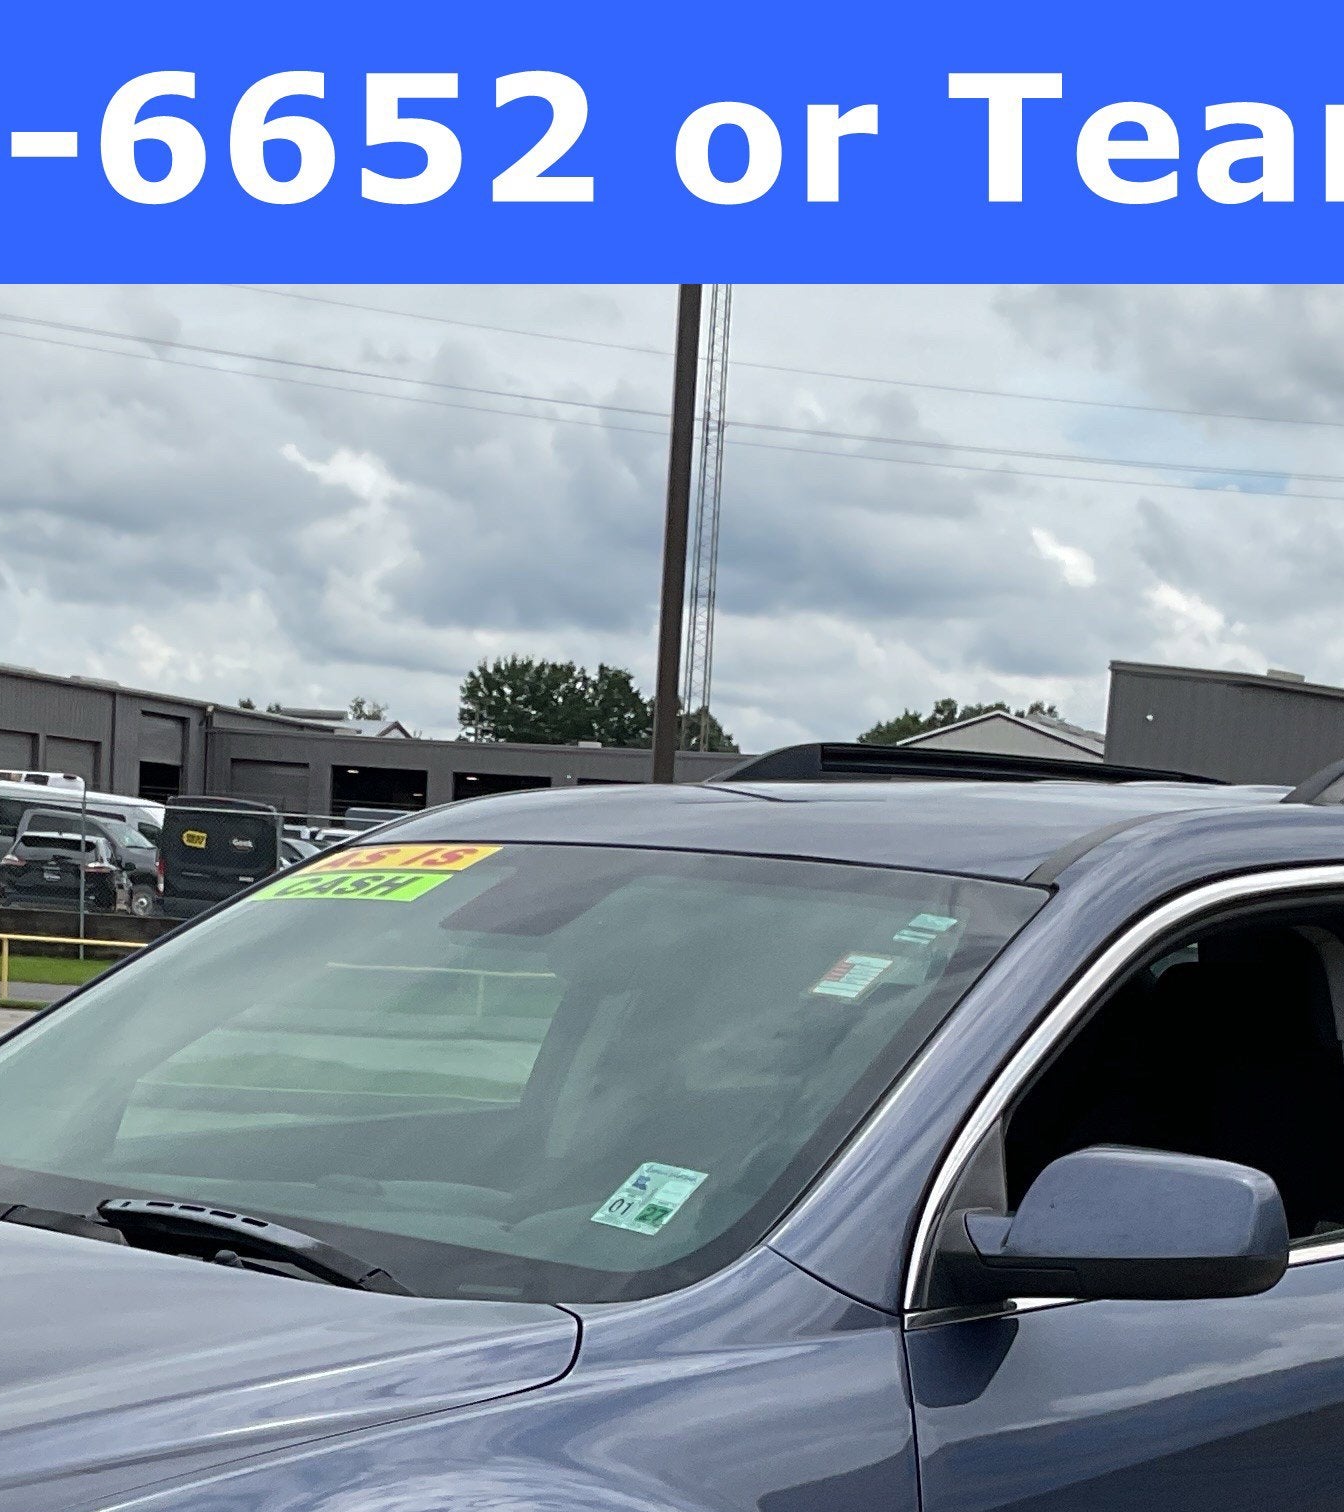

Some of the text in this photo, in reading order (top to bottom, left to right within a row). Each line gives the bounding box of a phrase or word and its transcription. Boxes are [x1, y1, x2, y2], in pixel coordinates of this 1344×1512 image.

[397, 847, 480, 867] IS
[272, 874, 424, 898] CASH
[608, 1198, 635, 1216] 01
